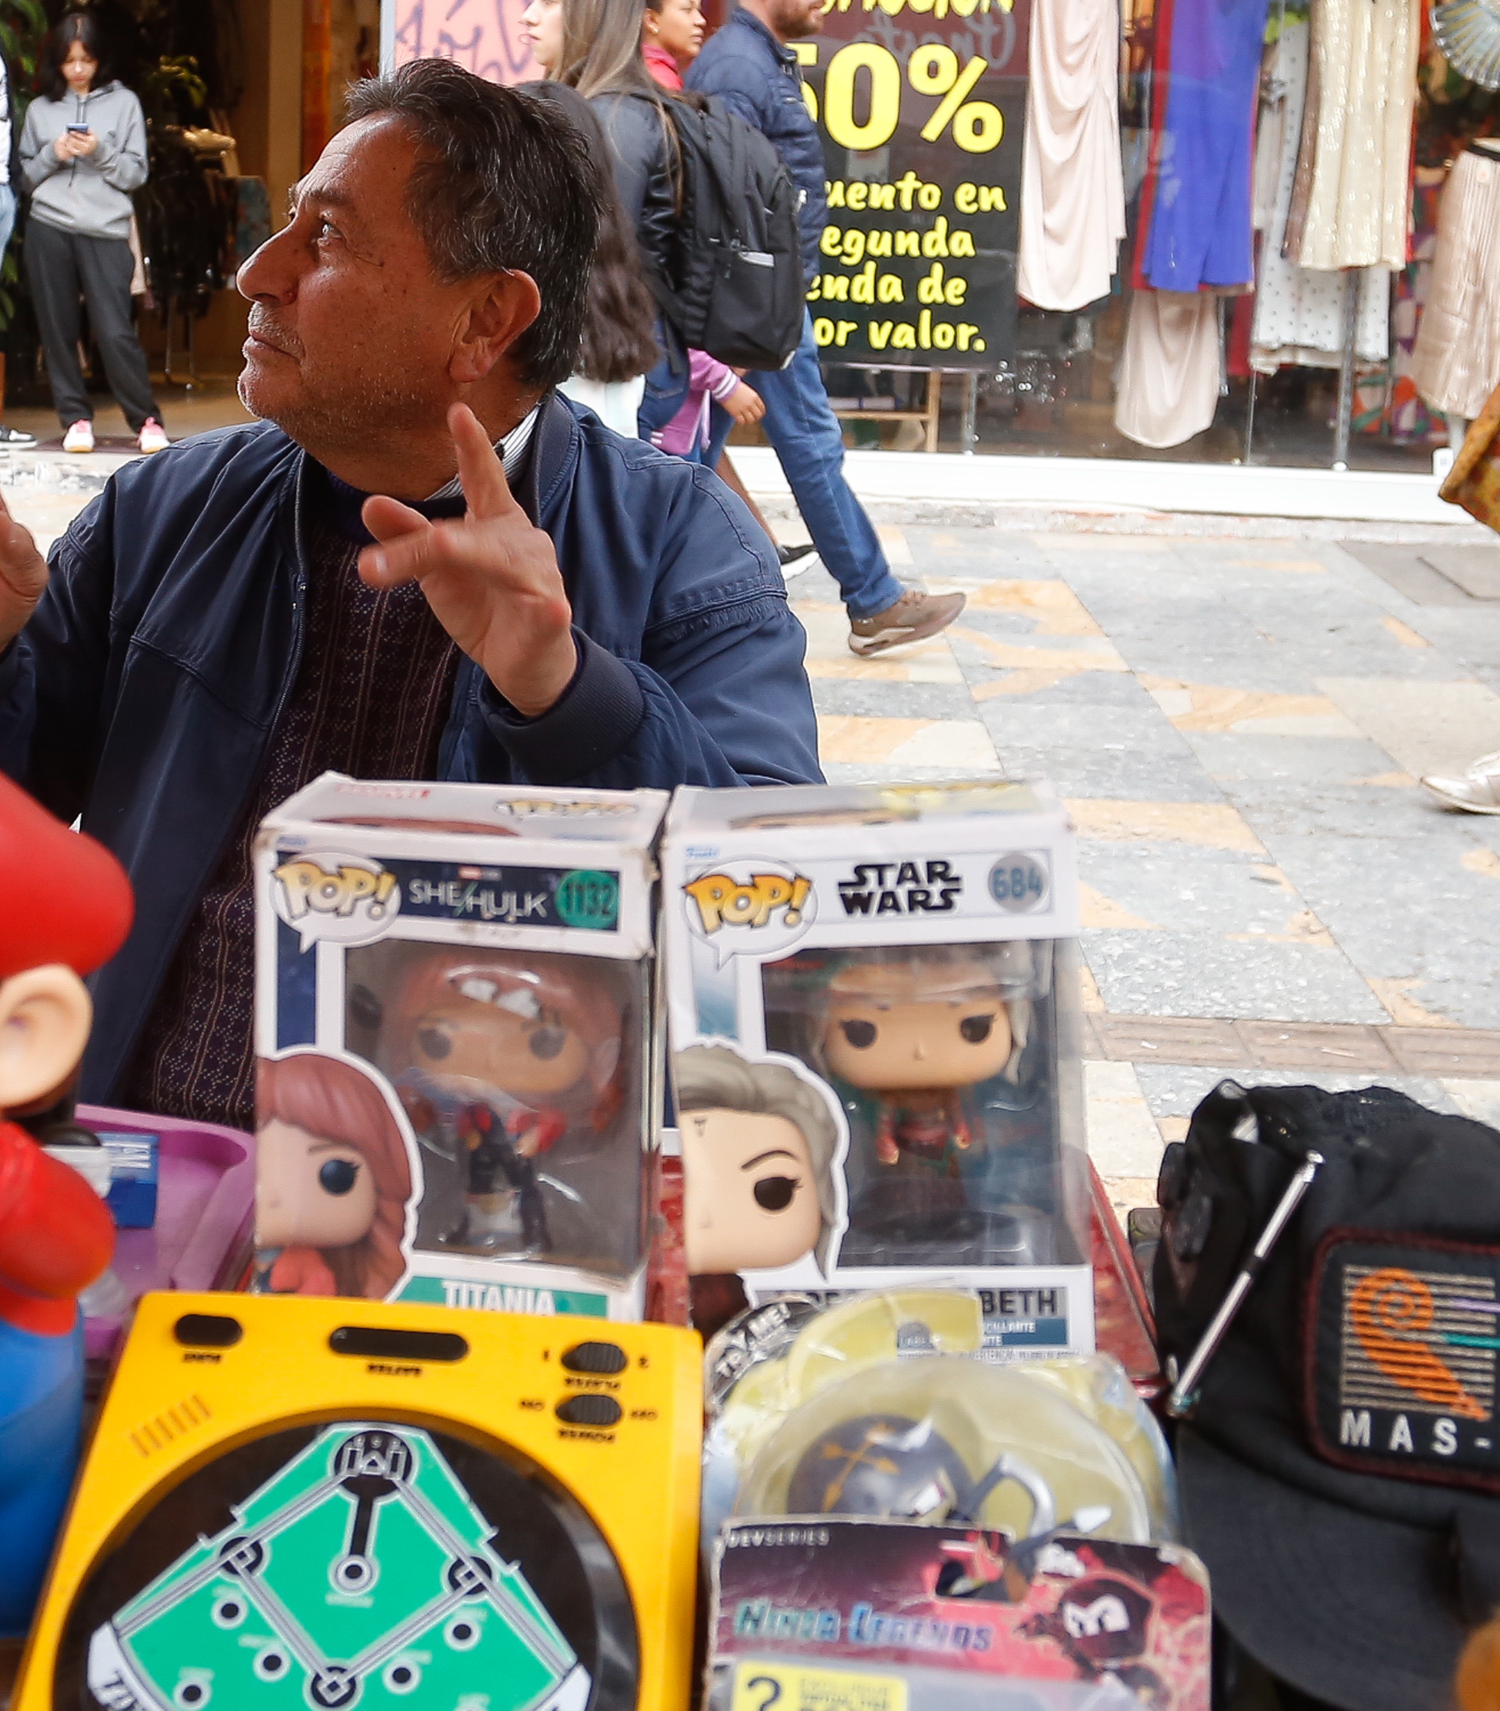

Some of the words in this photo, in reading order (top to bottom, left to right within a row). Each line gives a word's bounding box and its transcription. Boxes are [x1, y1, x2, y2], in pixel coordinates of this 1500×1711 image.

[785, 41, 1005, 153] 50%
[954, 183, 1007, 214] en
[819, 216, 976, 266] egunda
[917, 262, 967, 306] de
[813, 317, 858, 347] or
[868, 309, 986, 351] valor.
[275, 861, 397, 919] POP!
[838, 860, 961, 888] STAR
[992, 867, 1044, 903] 684
[682, 873, 812, 934] POP!
[840, 887, 961, 916] WARS
[444, 1281, 556, 1316] TITANIA
[979, 1289, 1057, 1316] BETH
